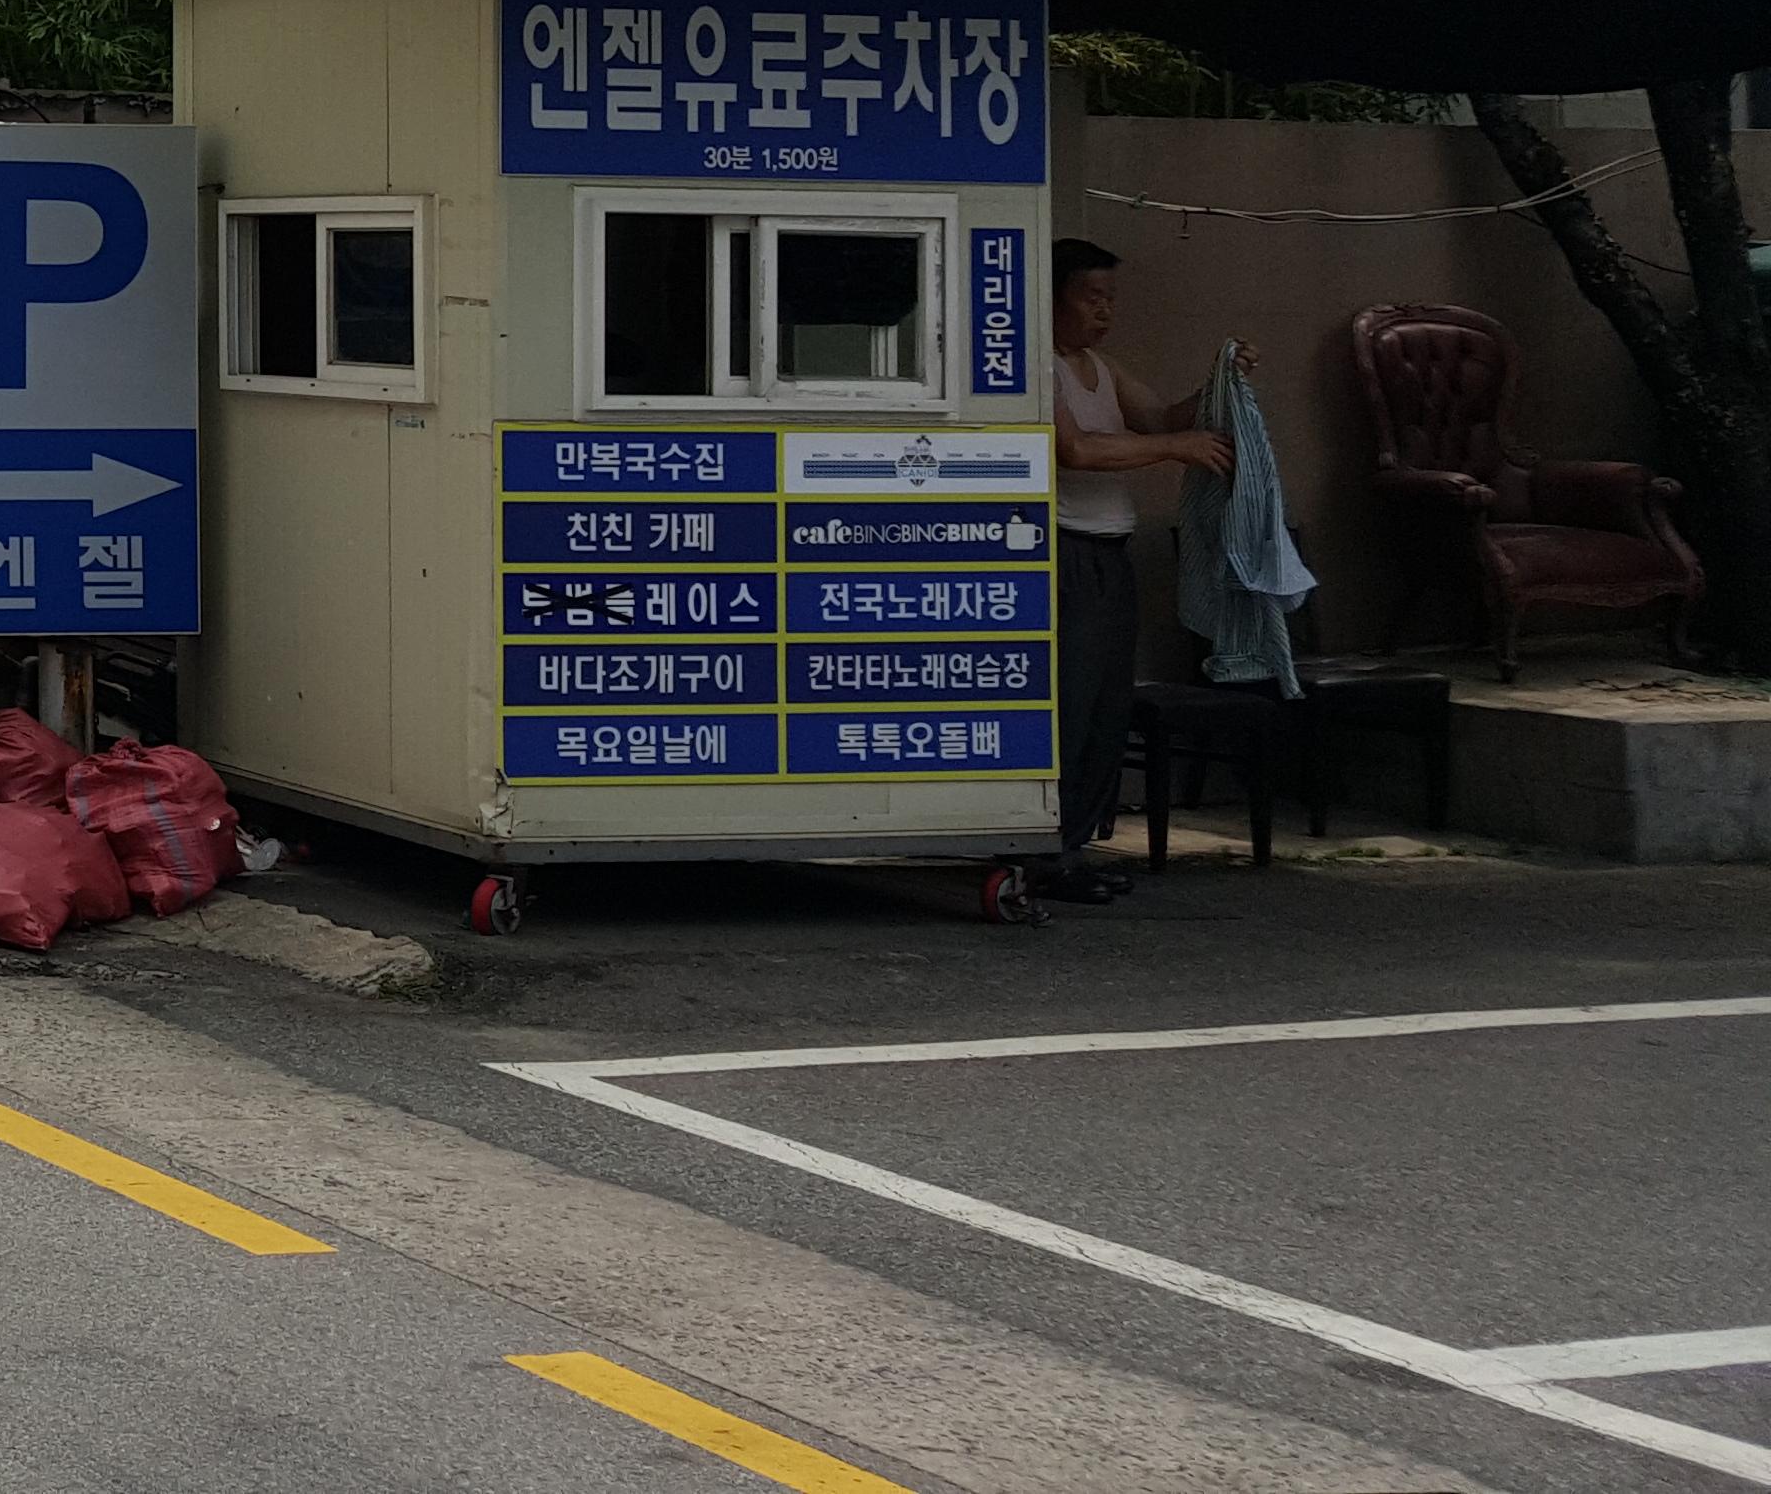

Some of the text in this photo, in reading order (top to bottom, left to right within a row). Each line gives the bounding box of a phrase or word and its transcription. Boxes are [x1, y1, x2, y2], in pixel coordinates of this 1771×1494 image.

[522, 3, 1029, 146] 엔젤유료주차장
[703, 146, 840, 173] 30분 1,500원
[981, 235, 1015, 389] 대리운전
[556, 442, 725, 482] 만복국수집
[566, 512, 715, 552] 친친 카페
[819, 581, 1019, 623] 전국노래자랑
[539, 654, 744, 694] 바다조개구이
[808, 653, 1031, 691] 칸타타노래연습장
[556, 725, 727, 765] 목요일날에
[837, 721, 1002, 760] 톡톡오돌뼈
